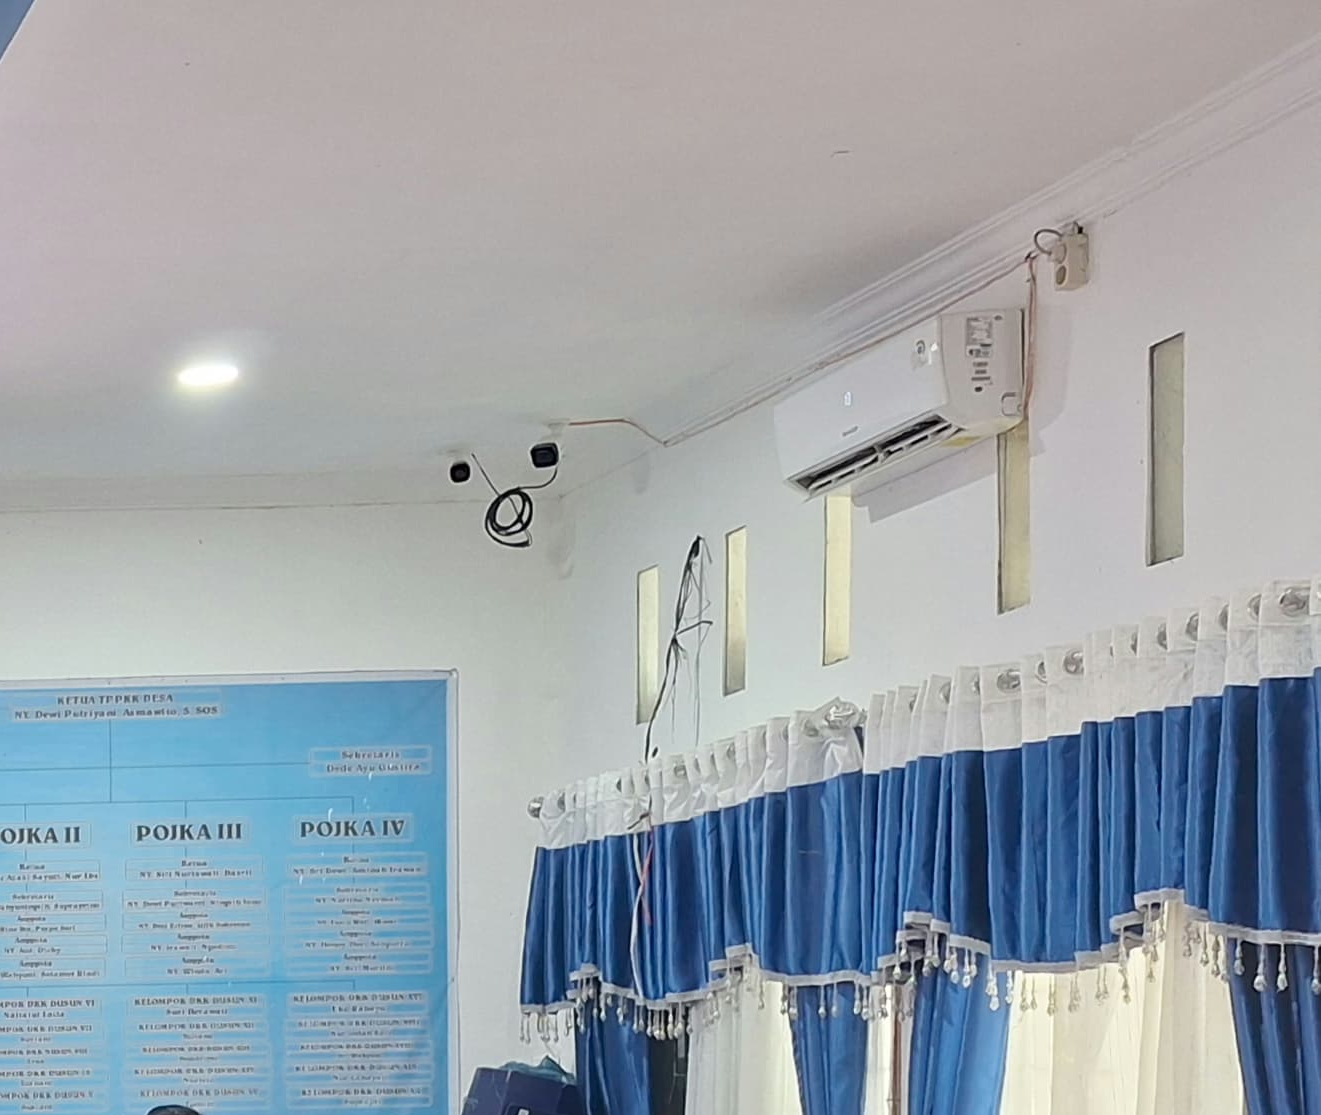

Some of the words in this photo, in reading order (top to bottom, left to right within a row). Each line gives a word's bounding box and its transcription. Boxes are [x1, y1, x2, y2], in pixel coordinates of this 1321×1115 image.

[64, 826, 81, 844] II
[136, 823, 212, 842] POJKA
[217, 823, 243, 840] III
[300, 820, 376, 838] POJKA
[382, 819, 405, 837] IV
